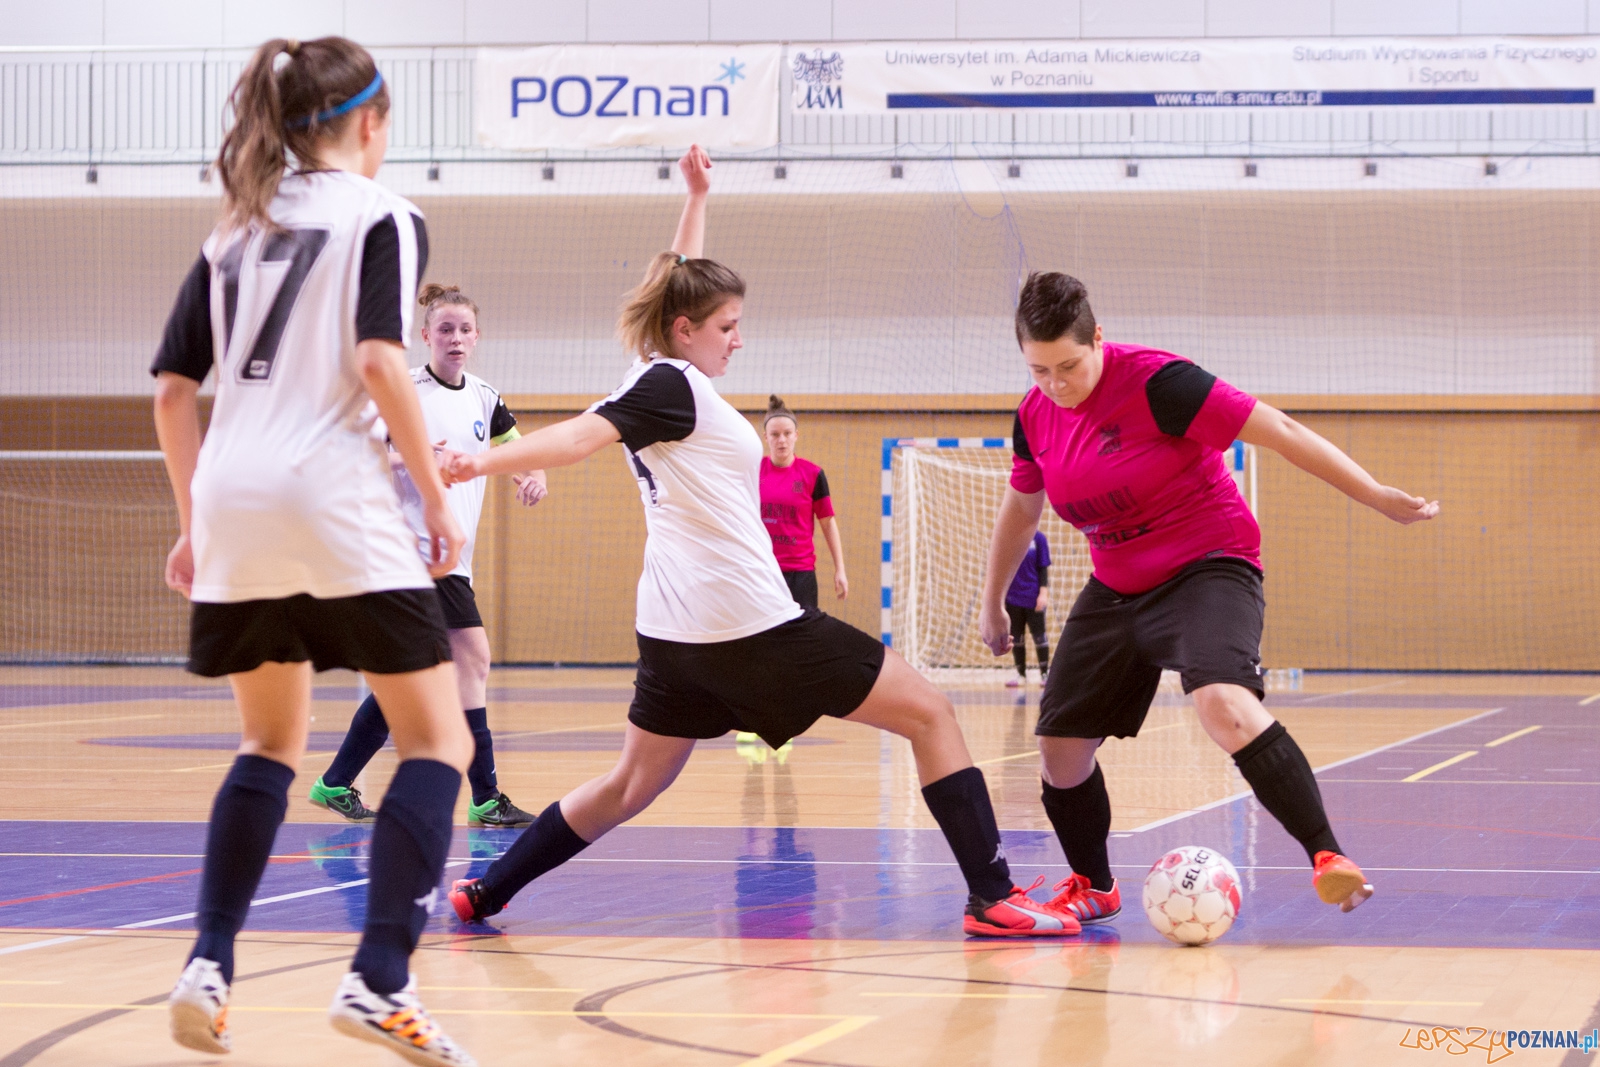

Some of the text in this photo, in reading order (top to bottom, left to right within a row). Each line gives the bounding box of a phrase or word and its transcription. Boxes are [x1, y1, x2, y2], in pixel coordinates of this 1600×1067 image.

[885, 47, 1201, 69] Uniwersytet im. Adama Mickiewicza
[1292, 45, 1598, 65] Studium Wychowania Fizycznego
[991, 71, 1094, 87] w Poznaniu
[1419, 67, 1480, 87] Sportu
[511, 75, 729, 118] POZnan
[1154, 91, 1322, 106] www.swfis.amu.edu.pl
[215, 226, 332, 384] 17
